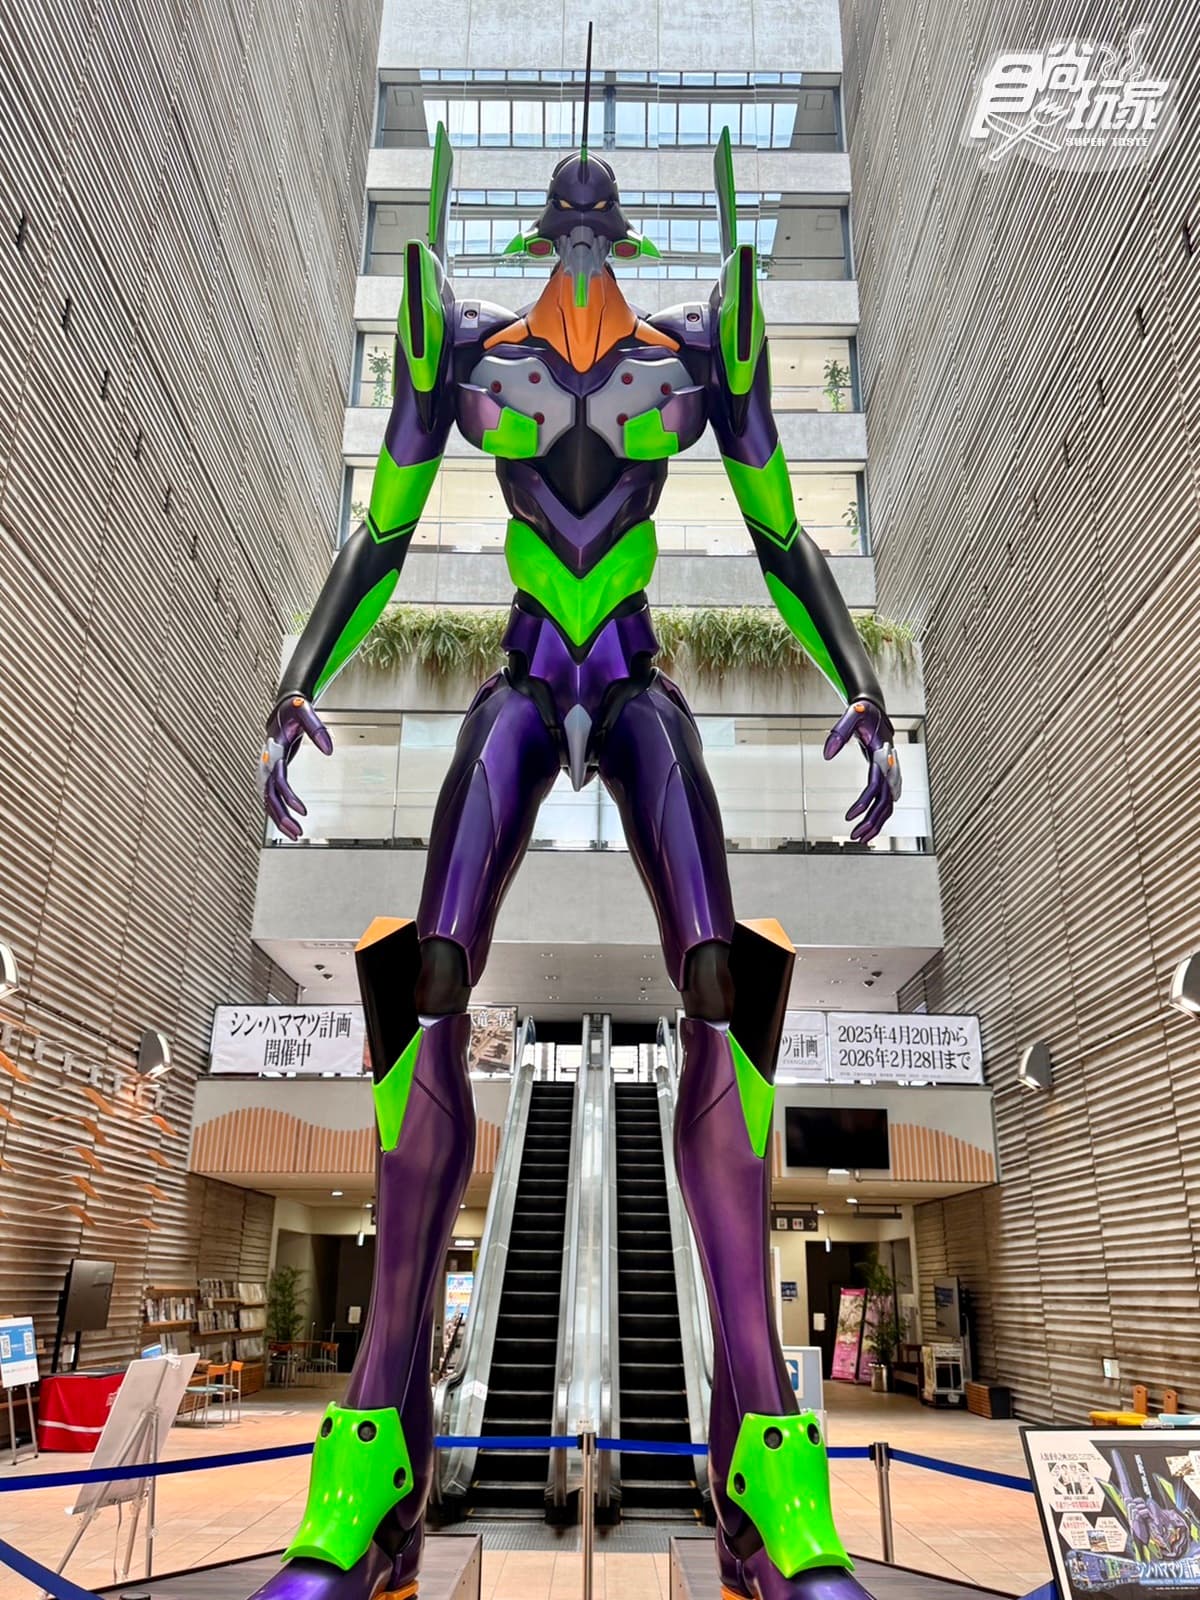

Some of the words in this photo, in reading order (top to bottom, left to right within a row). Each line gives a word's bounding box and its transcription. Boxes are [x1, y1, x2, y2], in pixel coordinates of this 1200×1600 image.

[230, 1011, 353, 1039] シン・ハママツ計画
[838, 1024, 968, 1047] 2025年4月20日から
[263, 1038, 312, 1067] 開催中
[839, 1047, 971, 1070] 2026年2月28日まで
